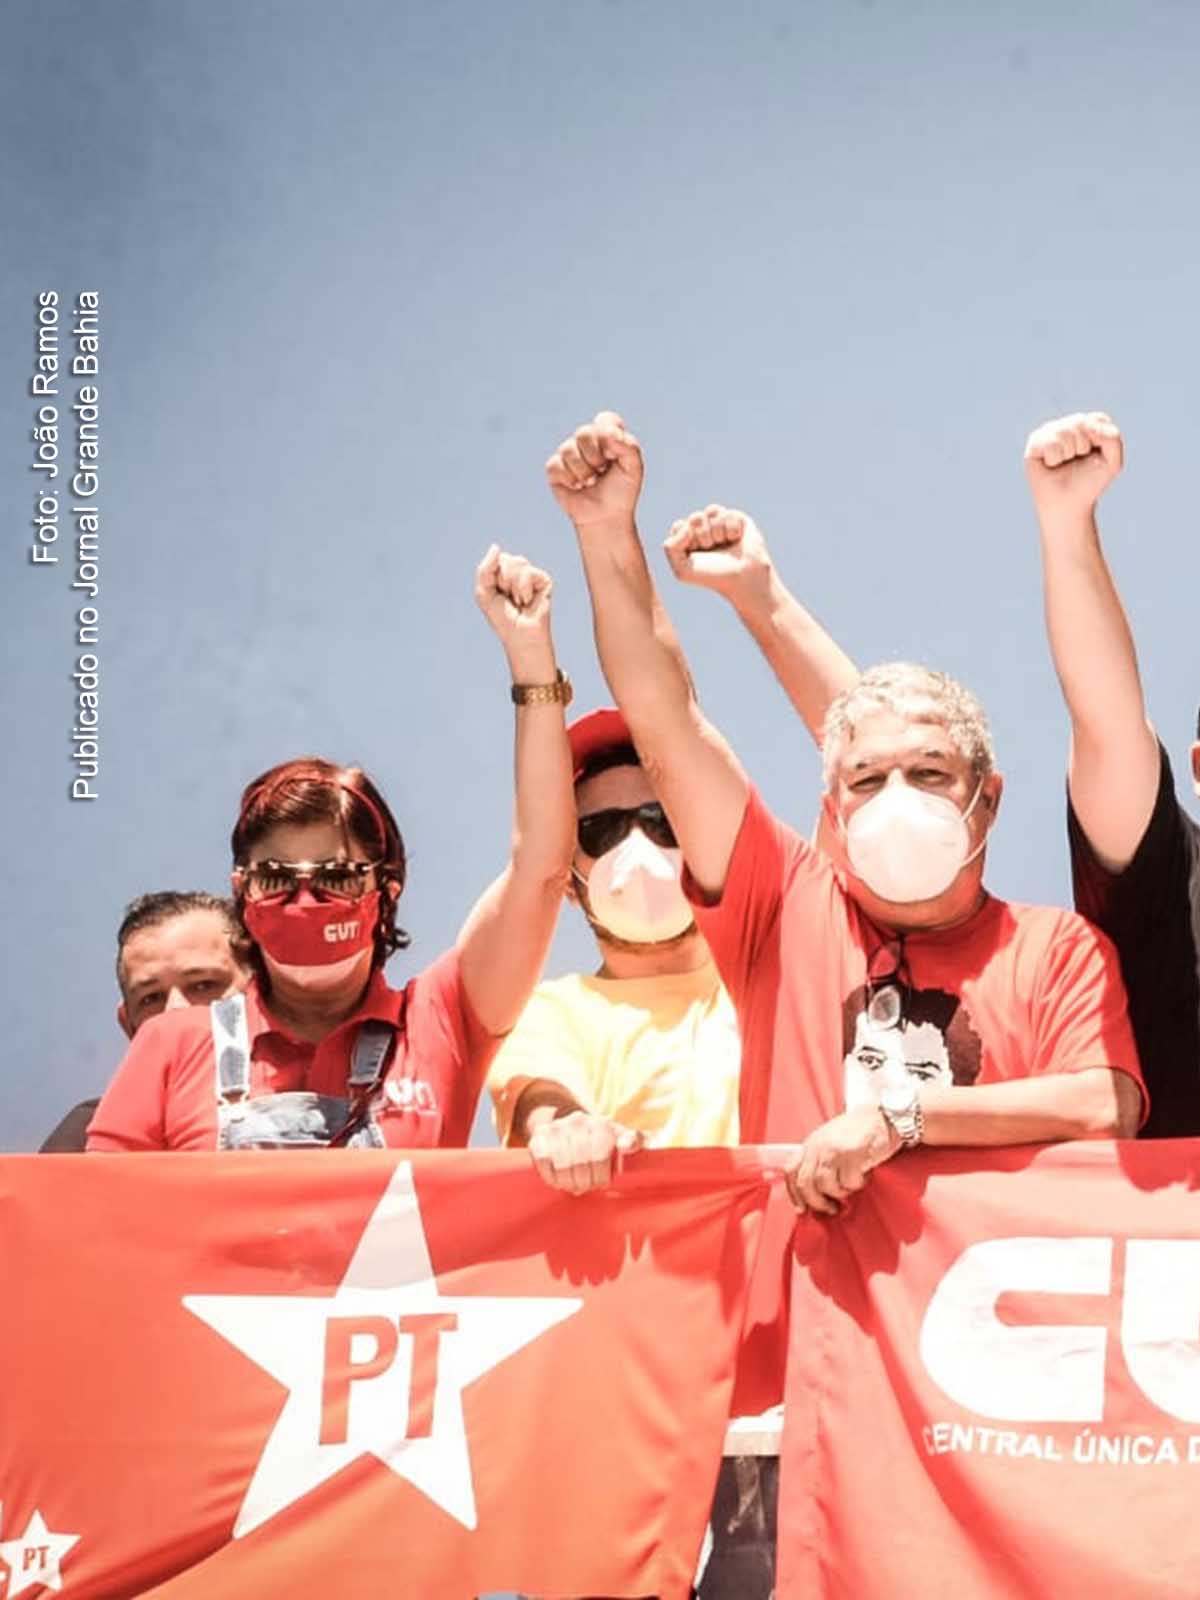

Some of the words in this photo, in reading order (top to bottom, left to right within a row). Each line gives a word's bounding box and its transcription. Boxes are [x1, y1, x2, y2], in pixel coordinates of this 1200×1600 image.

[323, 920, 360, 942] CUT
[318, 1313, 458, 1446] PT
[923, 1422, 1063, 1462] CENTRAL
[1073, 1428, 1180, 1466] ÚNICA
[22, 1544, 51, 1572] PT
